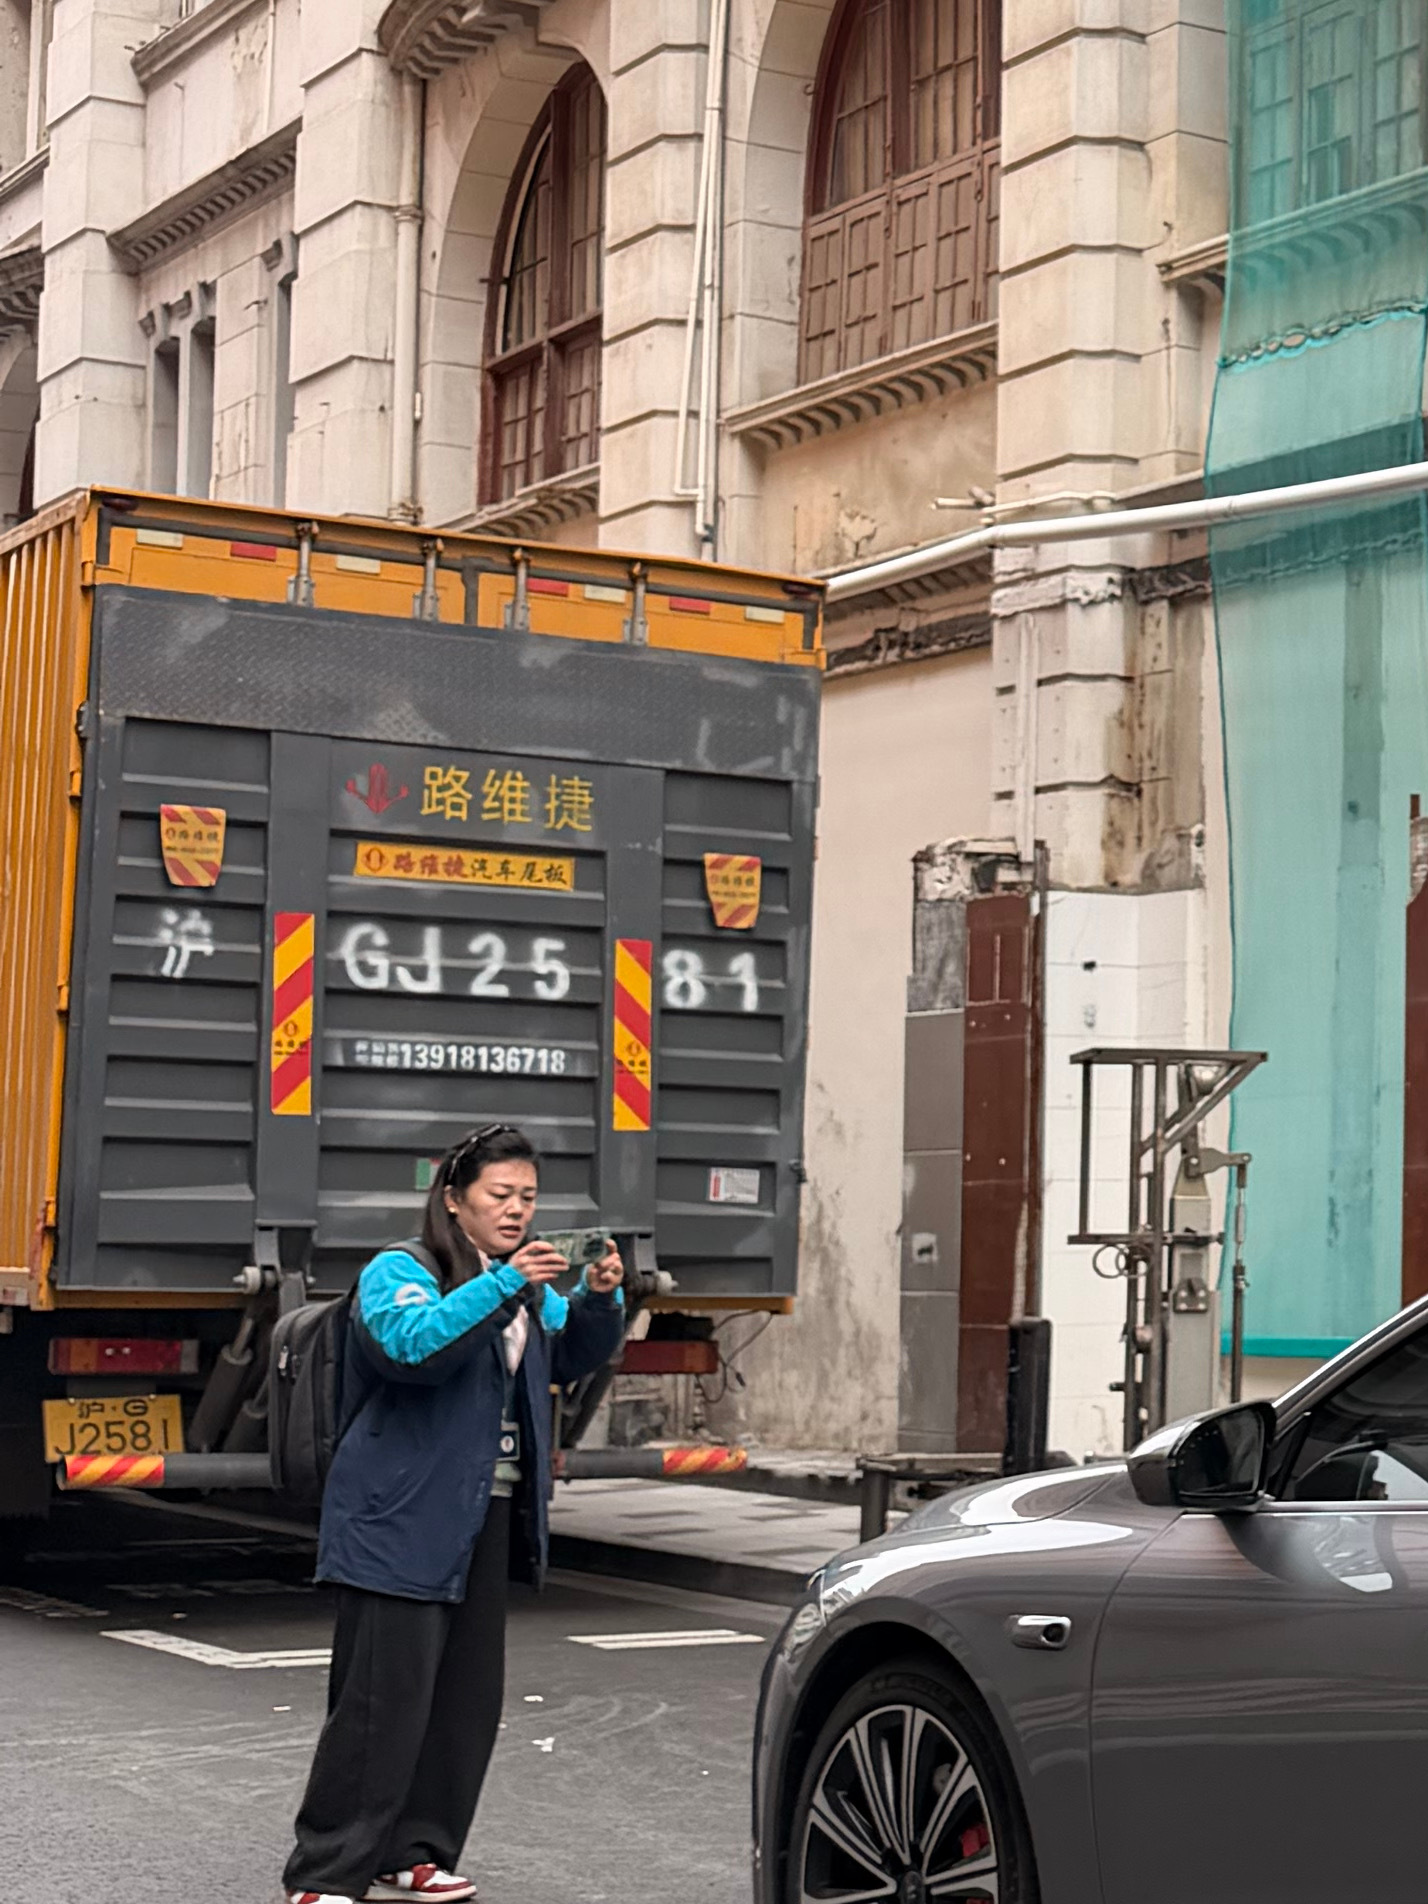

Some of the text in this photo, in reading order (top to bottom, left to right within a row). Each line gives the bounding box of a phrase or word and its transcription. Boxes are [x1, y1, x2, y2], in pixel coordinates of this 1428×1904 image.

[420, 765, 595, 833] 路维捷
[161, 908, 758, 1012] 沪 GJ25 81
[400, 1043, 566, 1075] 13918136718
[54, 1418, 169, 1456] J2581
